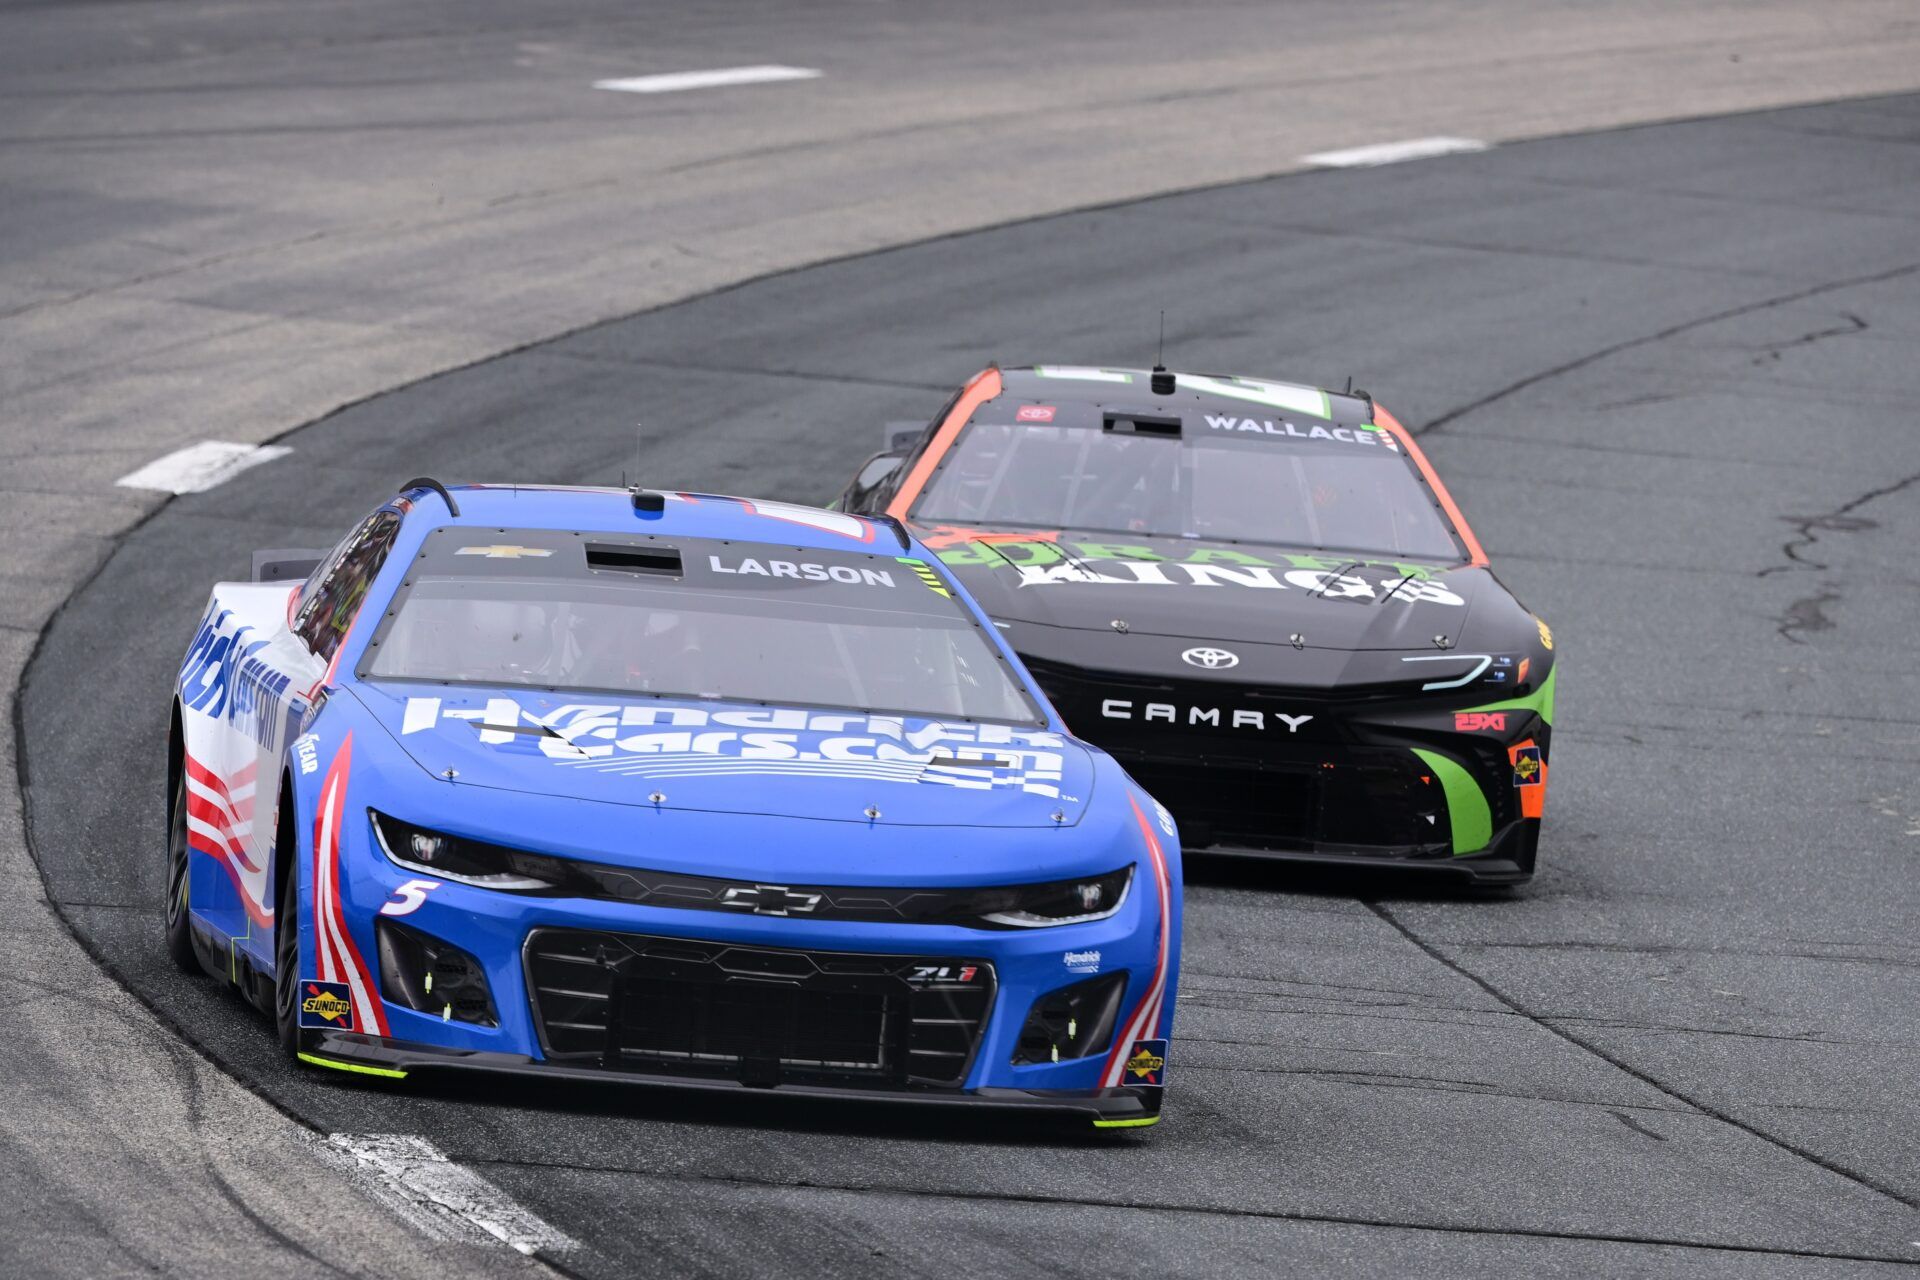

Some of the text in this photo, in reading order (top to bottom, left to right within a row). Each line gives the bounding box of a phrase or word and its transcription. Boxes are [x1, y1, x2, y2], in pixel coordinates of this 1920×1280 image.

[1203, 415, 1377, 446] WALLACE
[709, 555, 896, 588] LARSON
[1017, 558, 1465, 606] KINGS
[1101, 699, 1314, 733] CAMRY
[379, 879, 442, 916] 5
[907, 966, 977, 982] ZL1
[304, 999, 349, 1014] SUNOCO
[1127, 1056, 1163, 1072] SUNOCO
